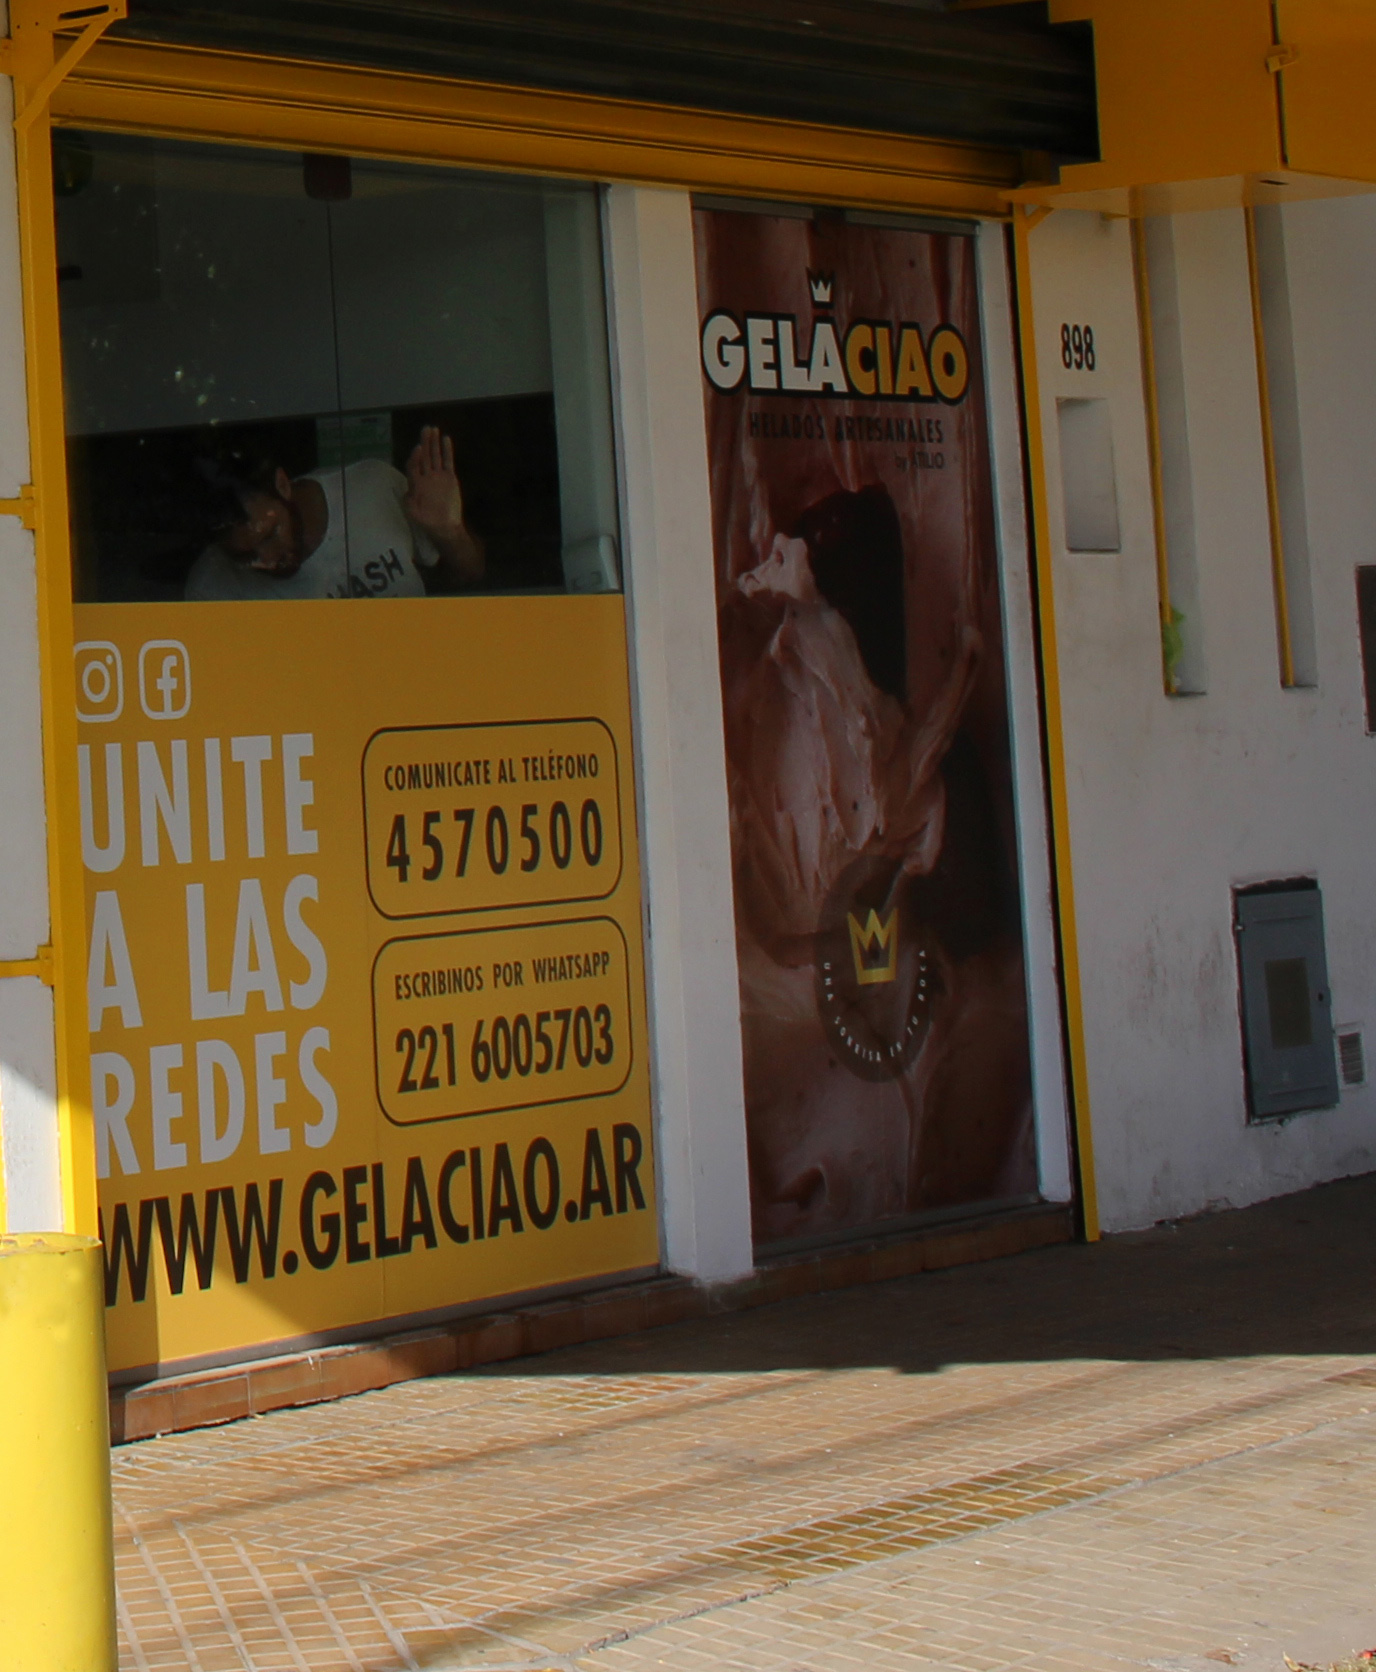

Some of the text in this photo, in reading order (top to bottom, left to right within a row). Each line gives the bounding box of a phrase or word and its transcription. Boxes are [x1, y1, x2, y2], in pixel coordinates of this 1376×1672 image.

[1061, 323, 1096, 371] 898
[77, 732, 319, 874] UNITE
[384, 749, 599, 791] COMUNICATE AL TELÉFONO
[386, 798, 603, 883] 4570500
[86, 873, 328, 1032] A LAS
[394, 950, 610, 1001] ESCRIBINOS POR WHATSAPP
[395, 1003, 614, 1094] 221 6005703
[90, 1026, 339, 1179] REDES
